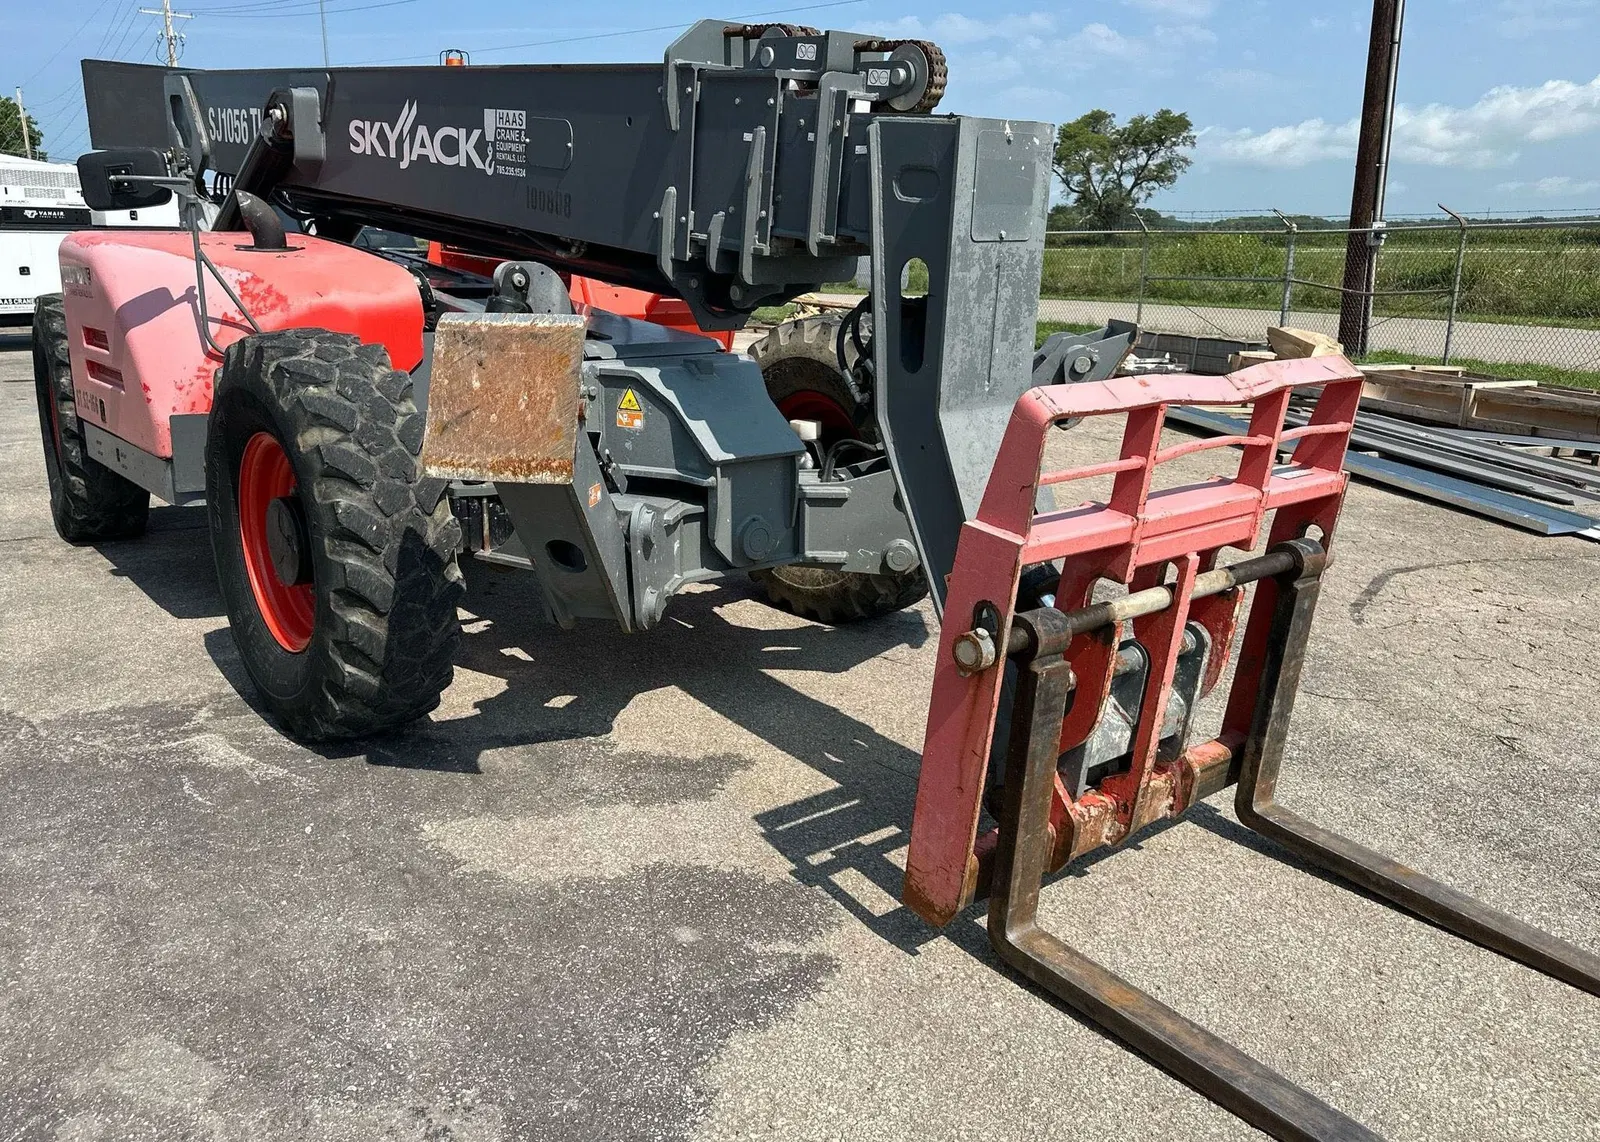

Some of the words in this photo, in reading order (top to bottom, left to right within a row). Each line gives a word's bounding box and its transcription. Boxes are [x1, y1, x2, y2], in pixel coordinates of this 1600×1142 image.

[208, 107, 248, 144] SJ1056
[499, 112, 524, 127] HAAS
[348, 99, 486, 170] SKYJACK
[496, 129, 519, 141] CRANE
[521, 130, 526, 142] &
[496, 142, 526, 153] EQUIPMENT
[496, 152, 516, 162] RENTALS,
